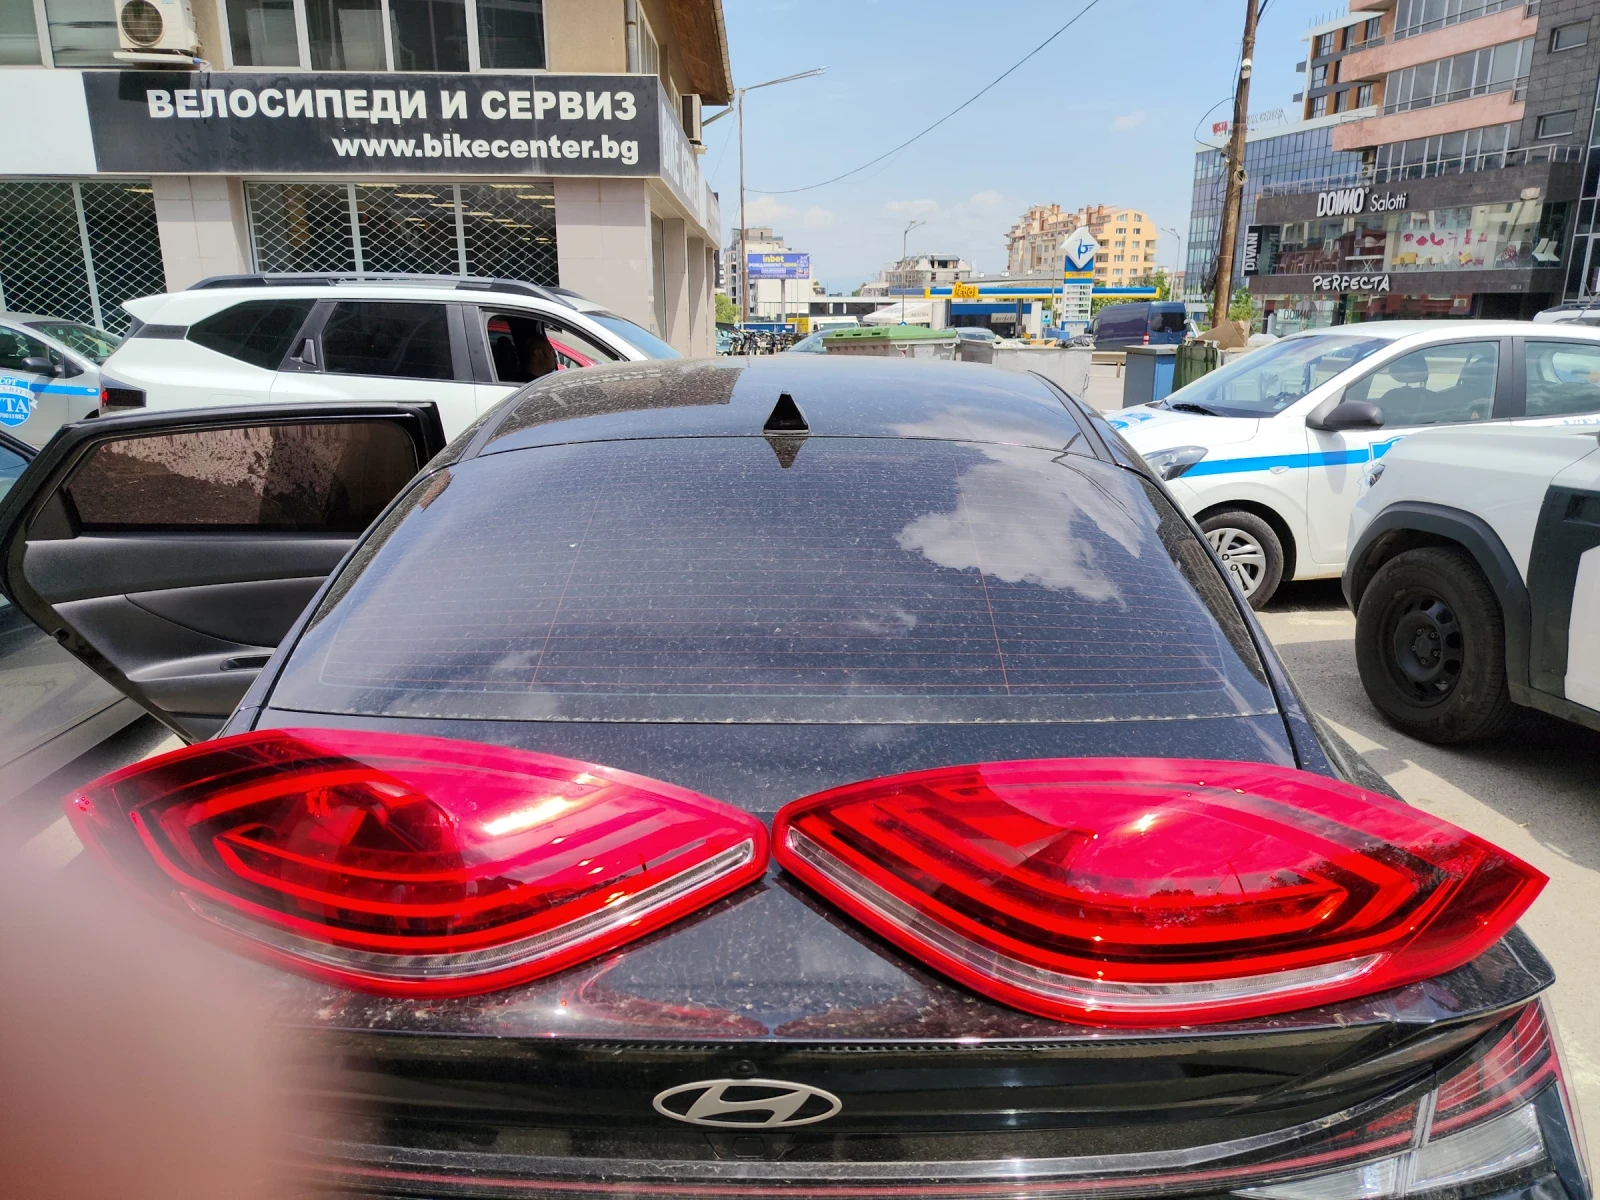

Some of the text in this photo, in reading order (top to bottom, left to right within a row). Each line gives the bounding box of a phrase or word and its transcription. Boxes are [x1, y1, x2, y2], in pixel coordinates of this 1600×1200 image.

[146, 88, 637, 125] ВЕЛОСИПЕДИ И СЕРВИЗ
[331, 133, 640, 165] www.bikecenter.bg
[661, 102, 680, 187] BIKE
[1316, 188, 1406, 217] DOIMO Salotti
[1244, 232, 1258, 270] DIVANI
[1312, 274, 1390, 292] PERFECTA
